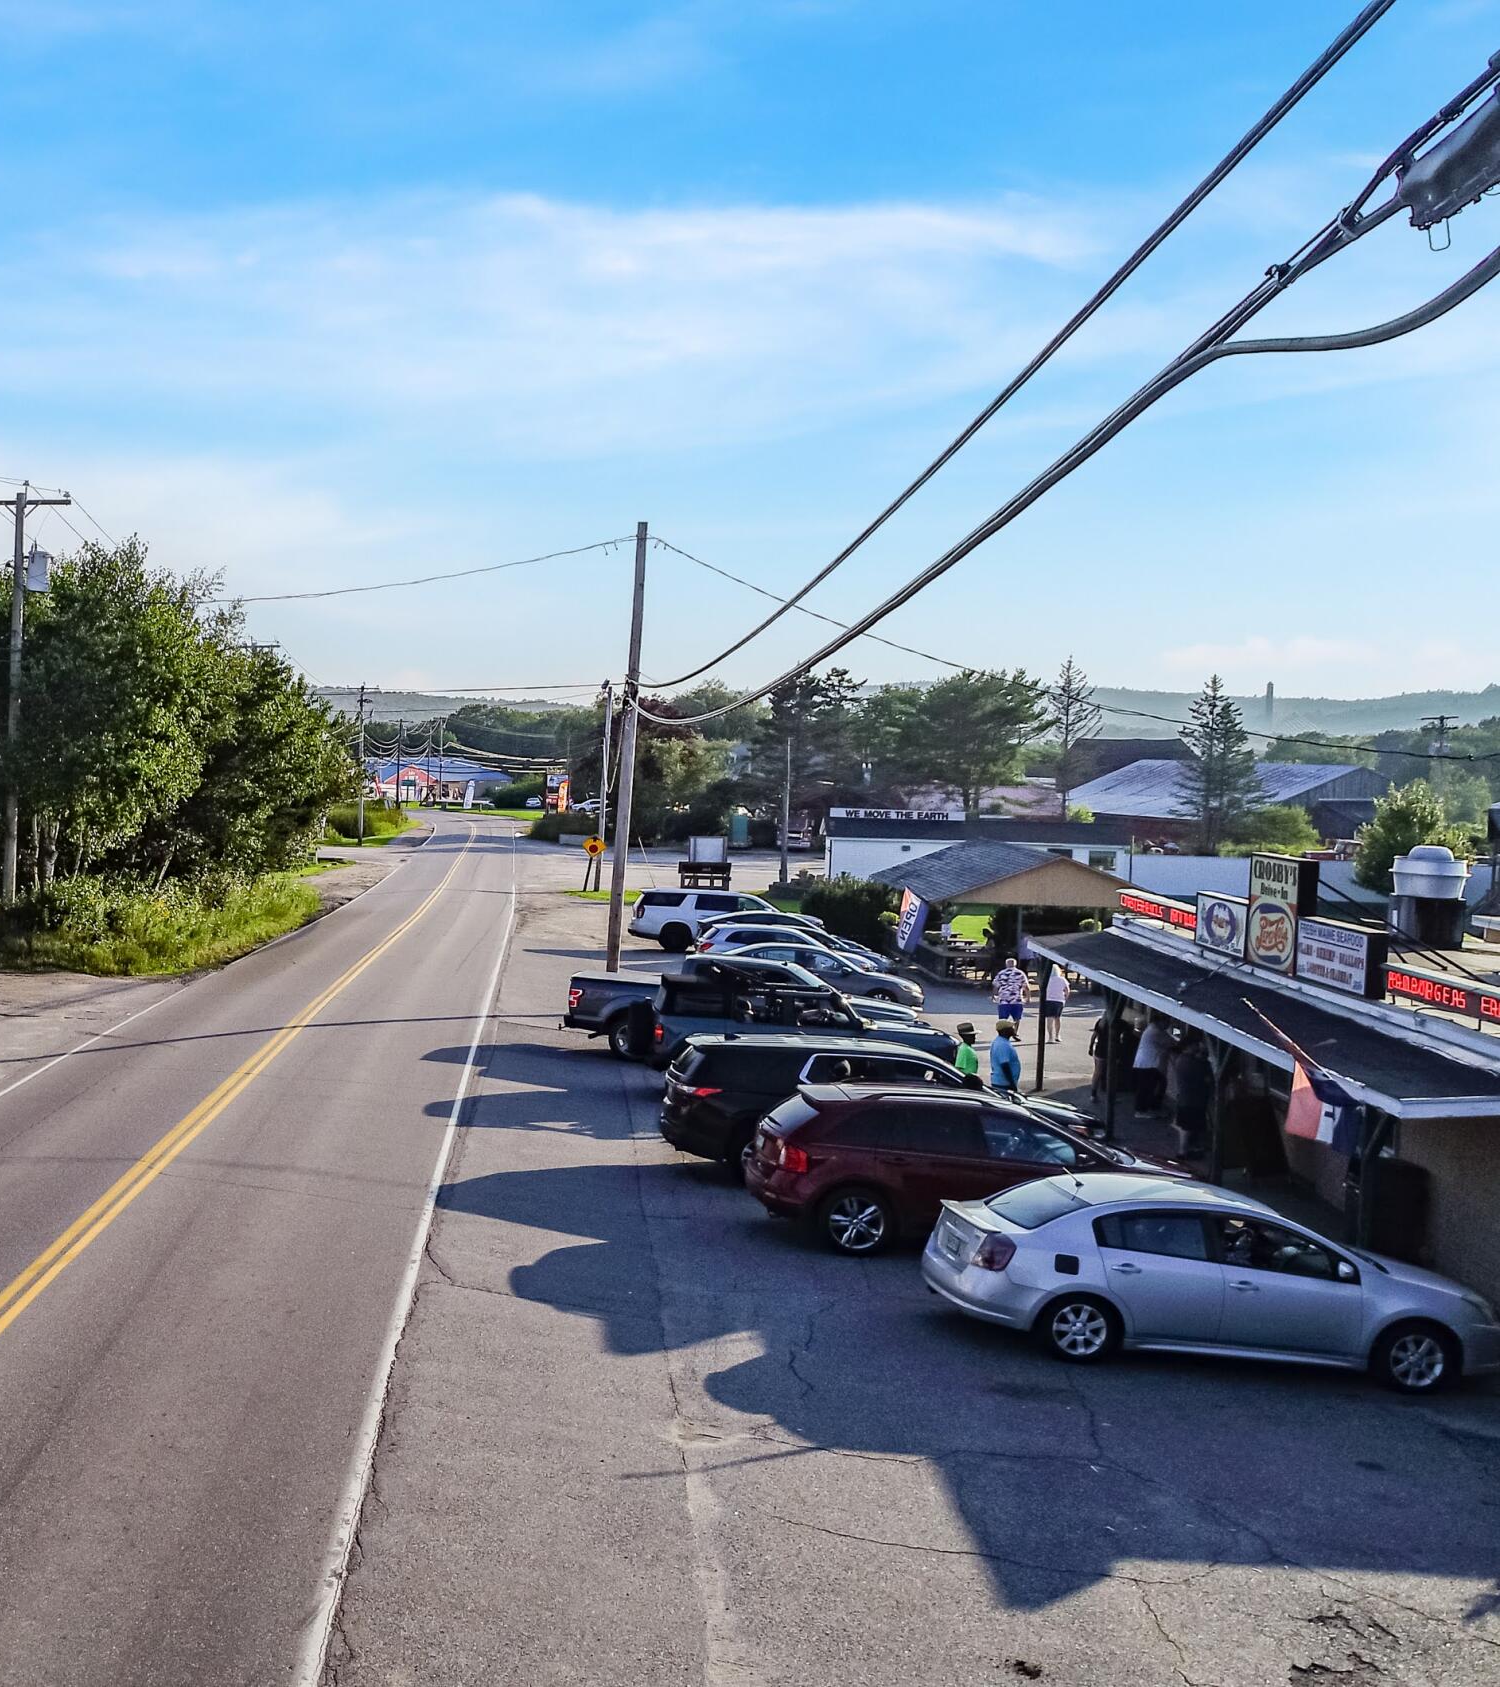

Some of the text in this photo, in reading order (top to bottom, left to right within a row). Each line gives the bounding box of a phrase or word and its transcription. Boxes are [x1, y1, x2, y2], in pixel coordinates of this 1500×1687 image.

[845, 810, 949, 820] WE MOVE THE EARTH
[1254, 859, 1298, 887] CROSBY'S
[1336, 930, 1365, 948] SEAFOOD
